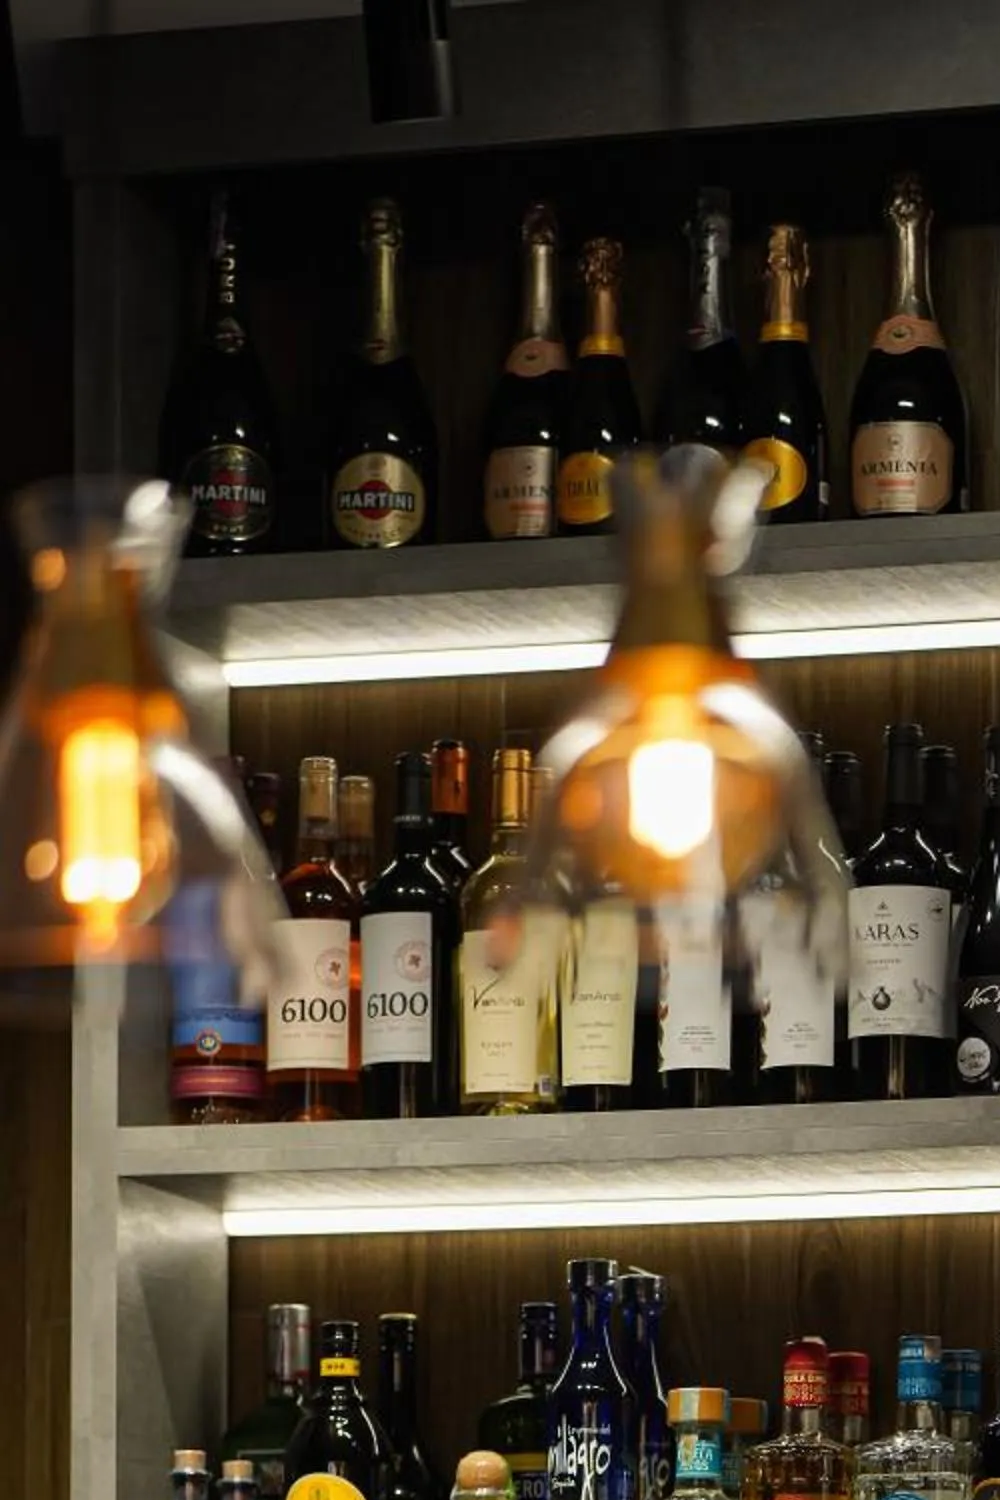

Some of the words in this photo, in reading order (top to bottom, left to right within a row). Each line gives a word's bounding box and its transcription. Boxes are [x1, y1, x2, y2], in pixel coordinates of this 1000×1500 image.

[860, 460, 939, 477] ARMENIA
[191, 484, 267, 506] MARTINI
[340, 491, 414, 510] MARTINI
[281, 997, 347, 1024] 6100
[366, 991, 429, 1019] 6100
